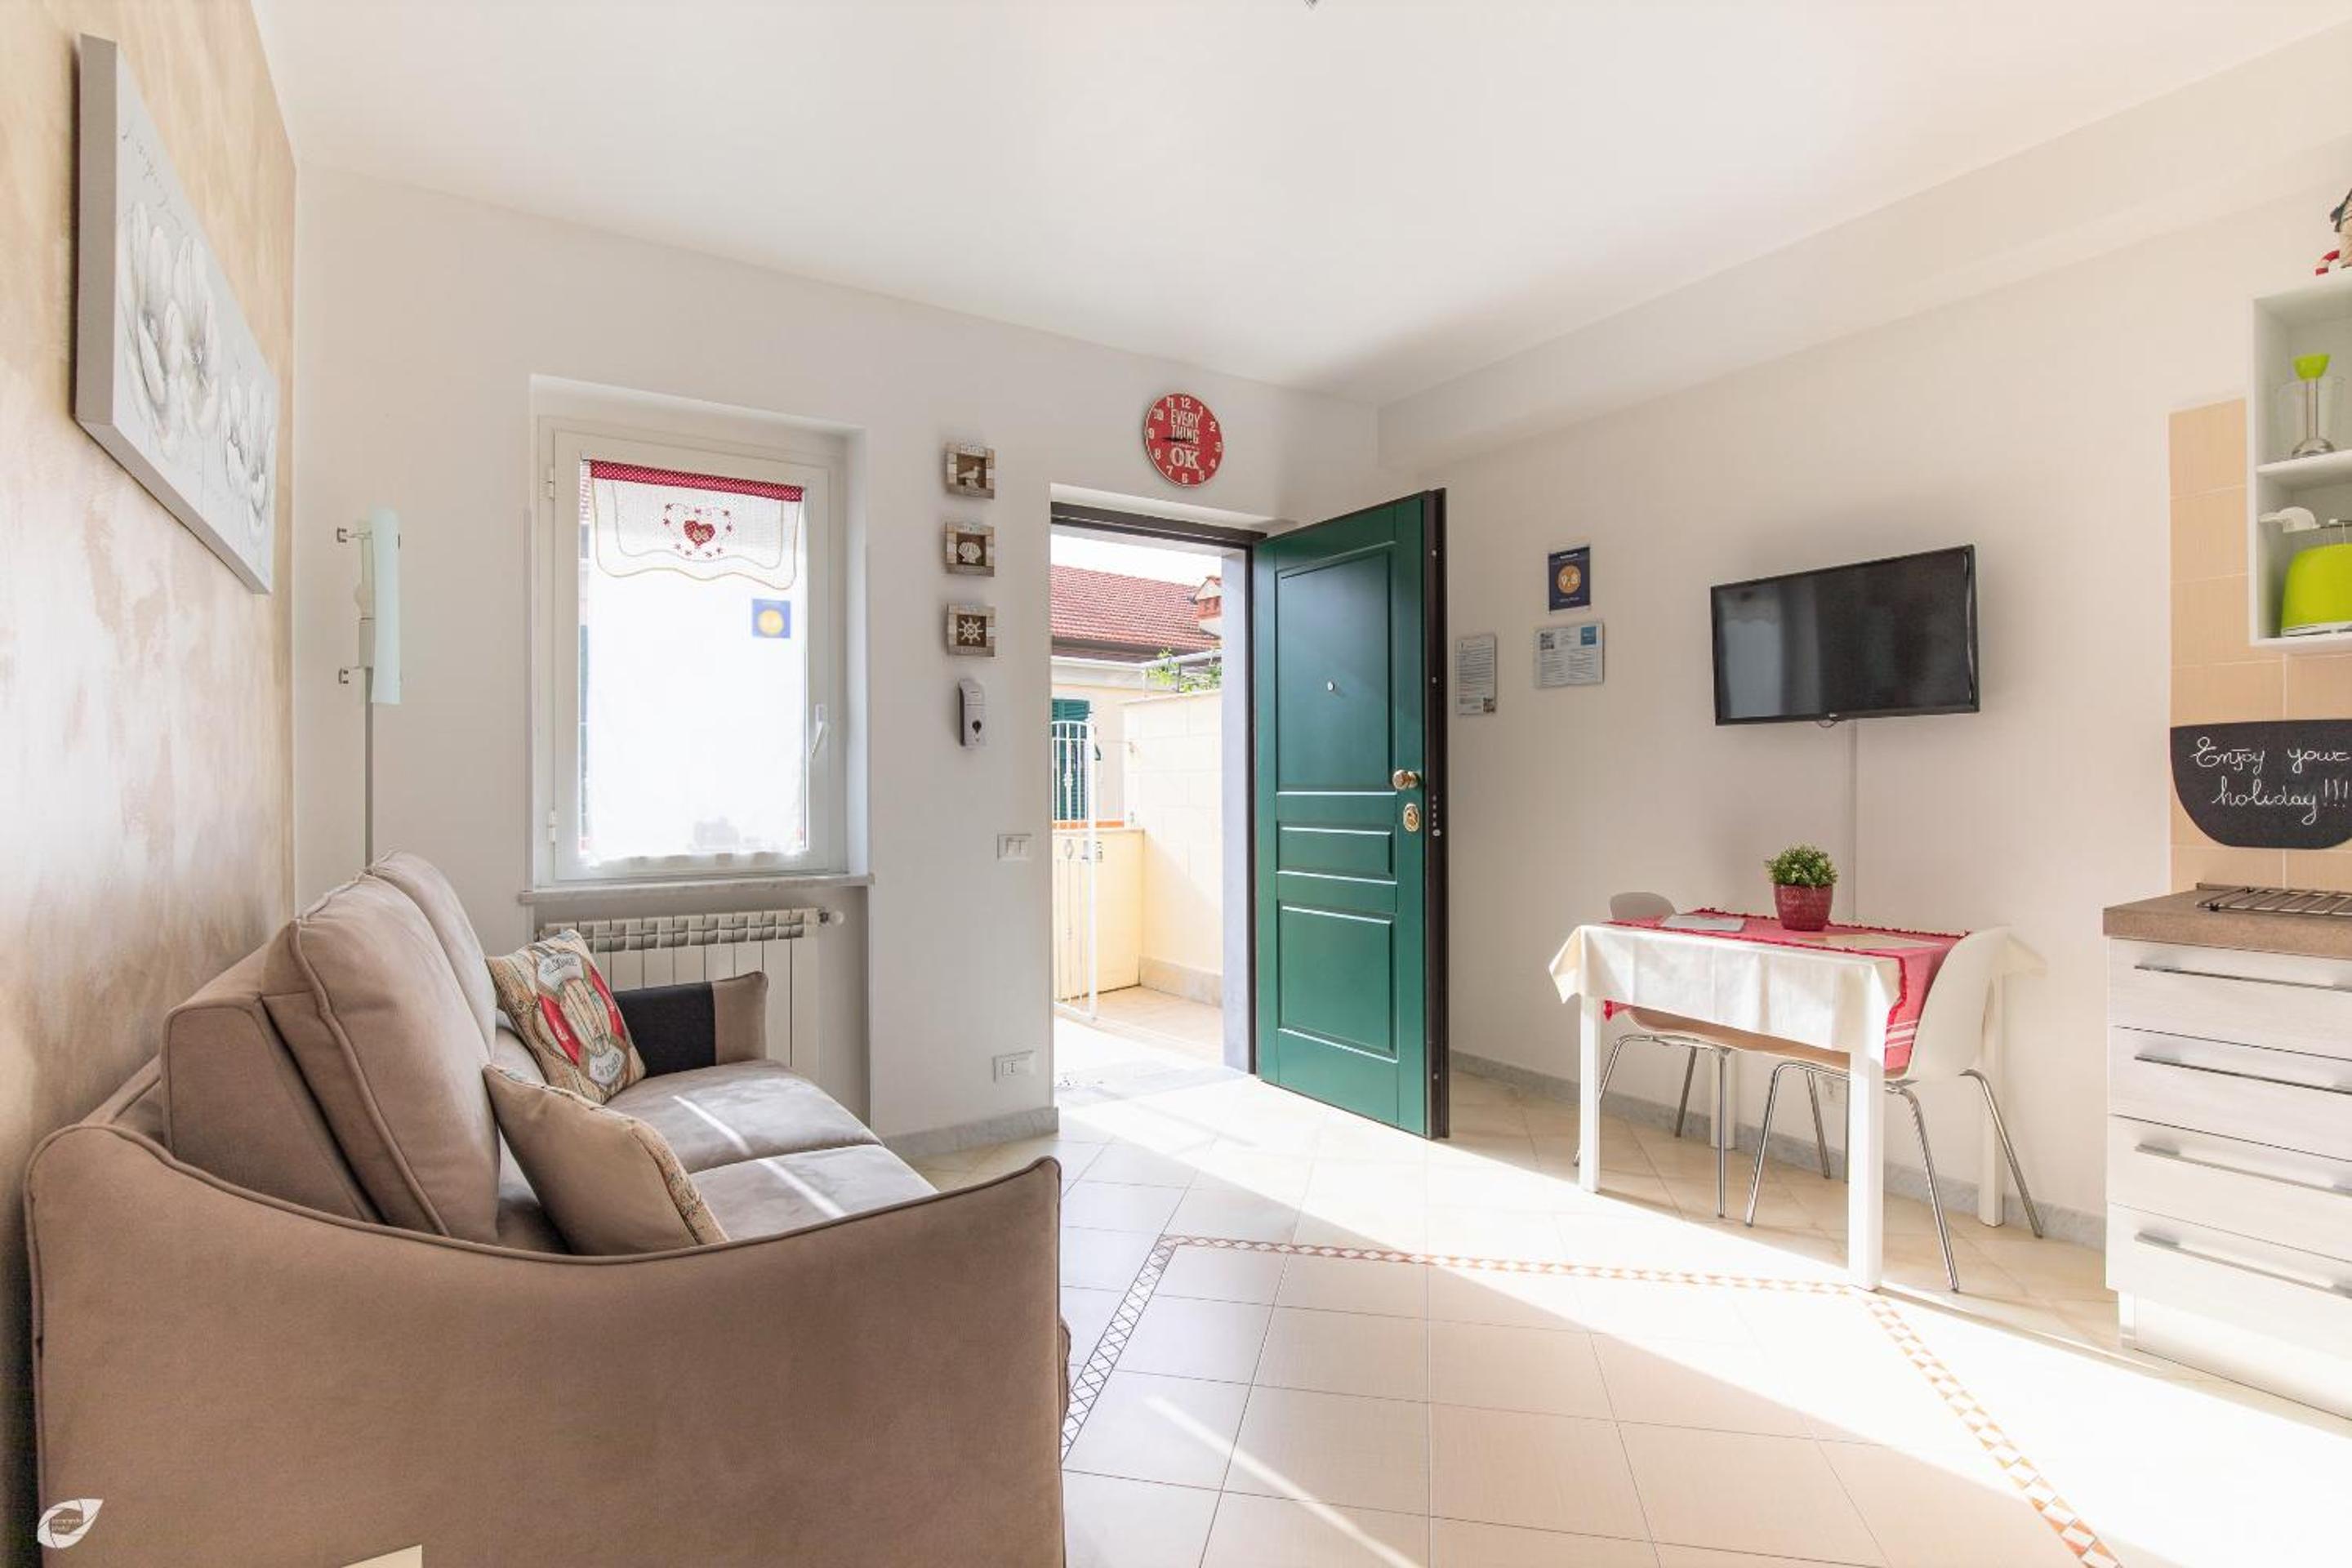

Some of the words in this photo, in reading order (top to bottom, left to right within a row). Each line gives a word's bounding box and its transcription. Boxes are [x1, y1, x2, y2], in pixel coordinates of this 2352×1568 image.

[1166, 396, 1174, 408] 11
[1180, 397, 1191, 409] 12
[1154, 408, 1164, 421] 10
[1199, 406, 1204, 416] 1
[1170, 409, 1200, 428] EVERY
[1209, 421, 1216, 432] 2
[1148, 427, 1155, 439] 9
[1171, 425, 1200, 444] THING
[1215, 441, 1222, 452] 3
[1155, 448, 1161, 460] 8
[1169, 448, 1200, 470] OK
[1209, 458, 1216, 469] 4
[1166, 466, 1174, 475] 7
[1182, 473, 1188, 483] 6
[2189, 737, 2265, 775] Enjoy
[2287, 748, 2350, 774] your
